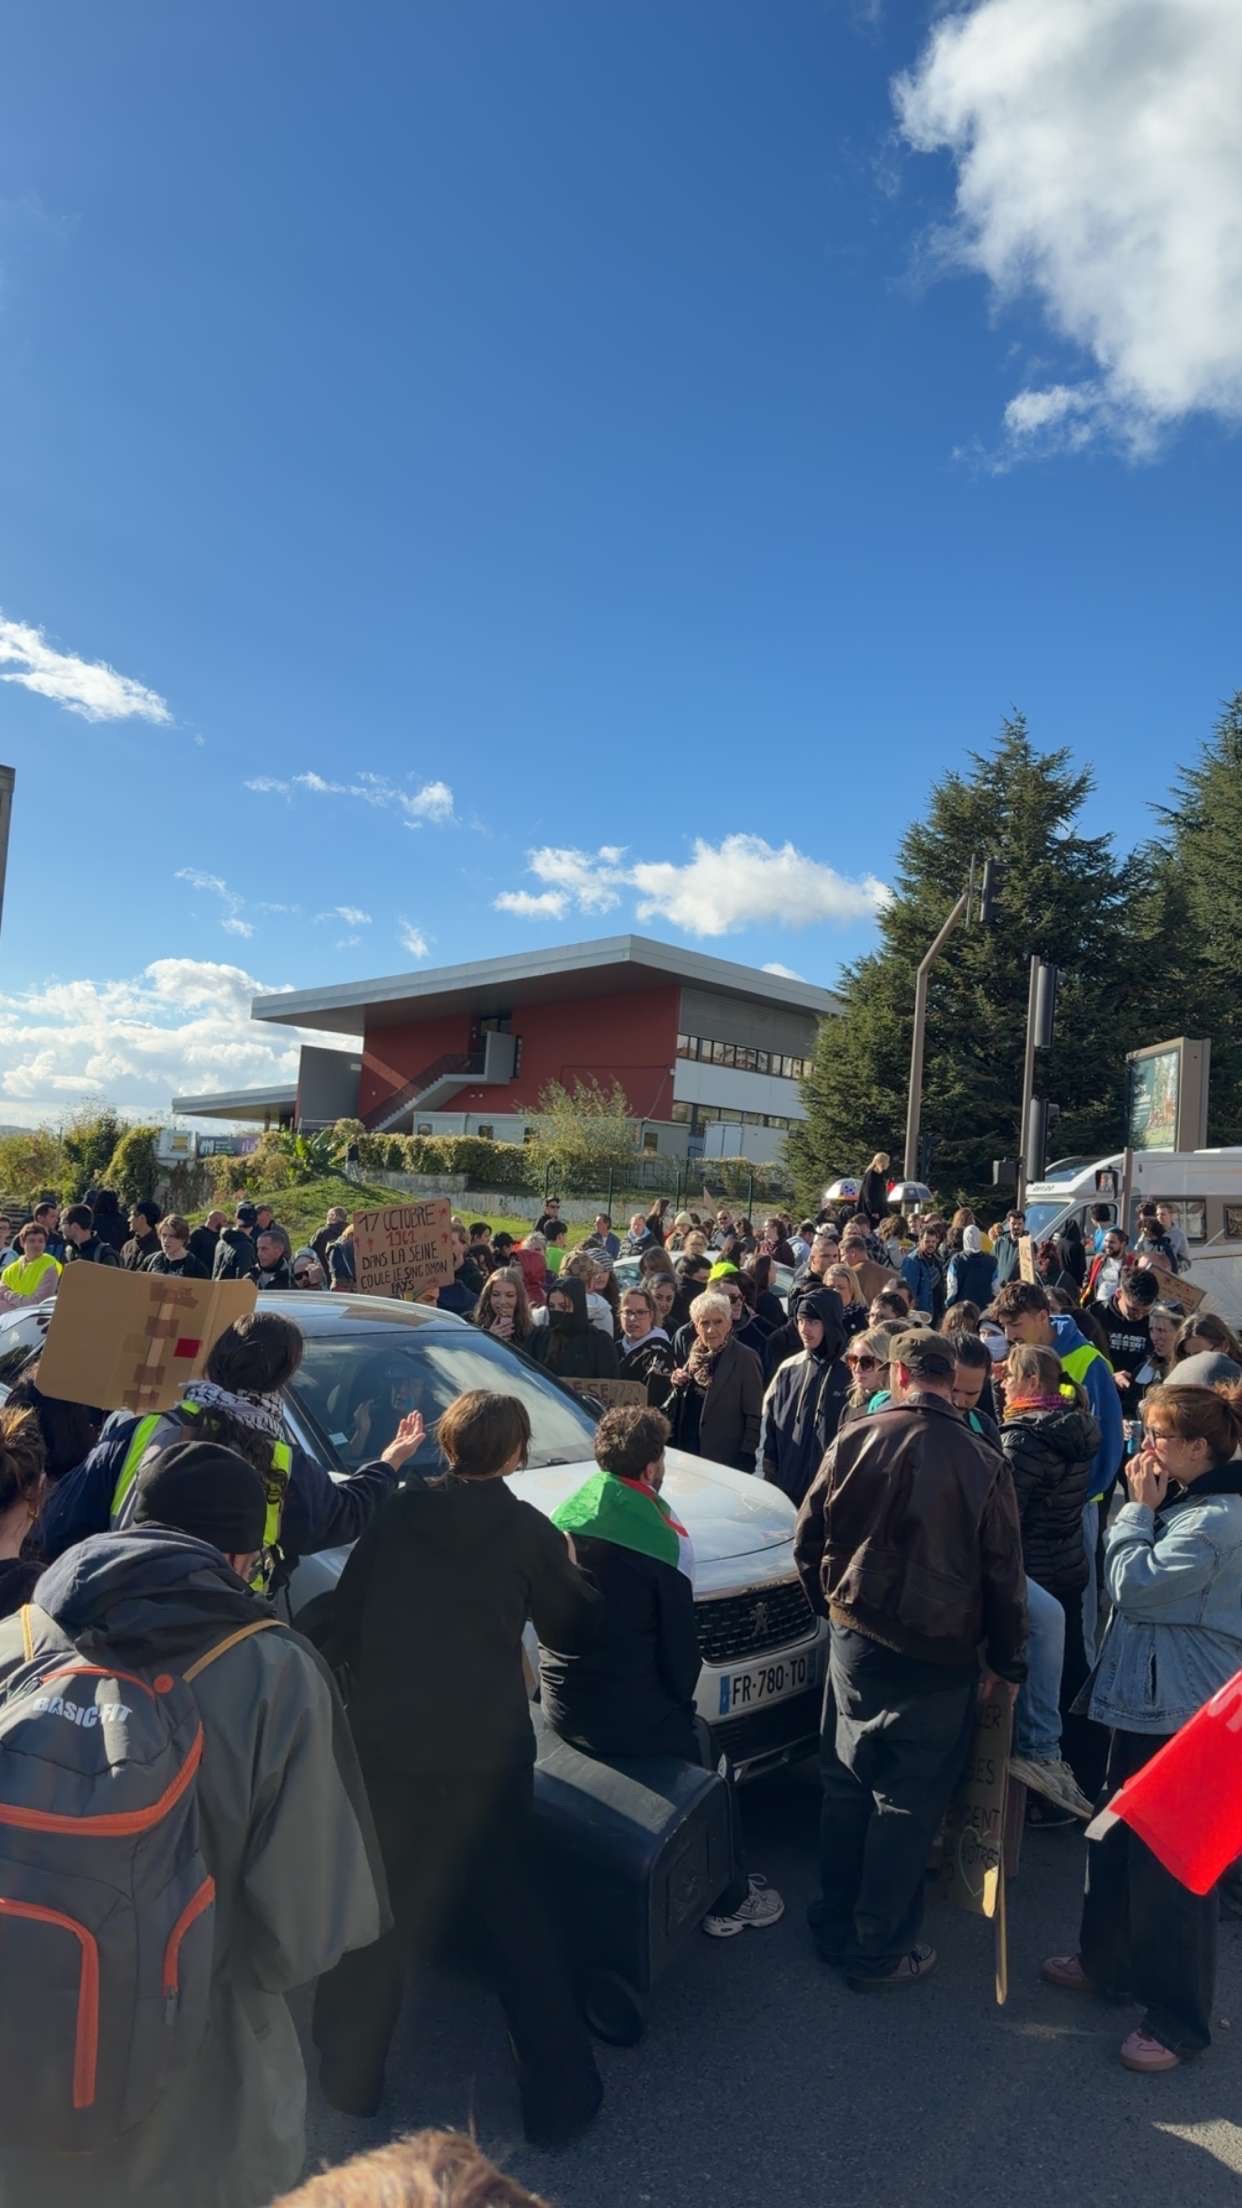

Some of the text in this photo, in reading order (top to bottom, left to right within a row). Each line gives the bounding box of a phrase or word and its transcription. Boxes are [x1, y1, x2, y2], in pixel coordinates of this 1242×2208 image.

[359, 1212, 379, 1232] 17
[362, 1240, 439, 1270] DANS LA SEINE
